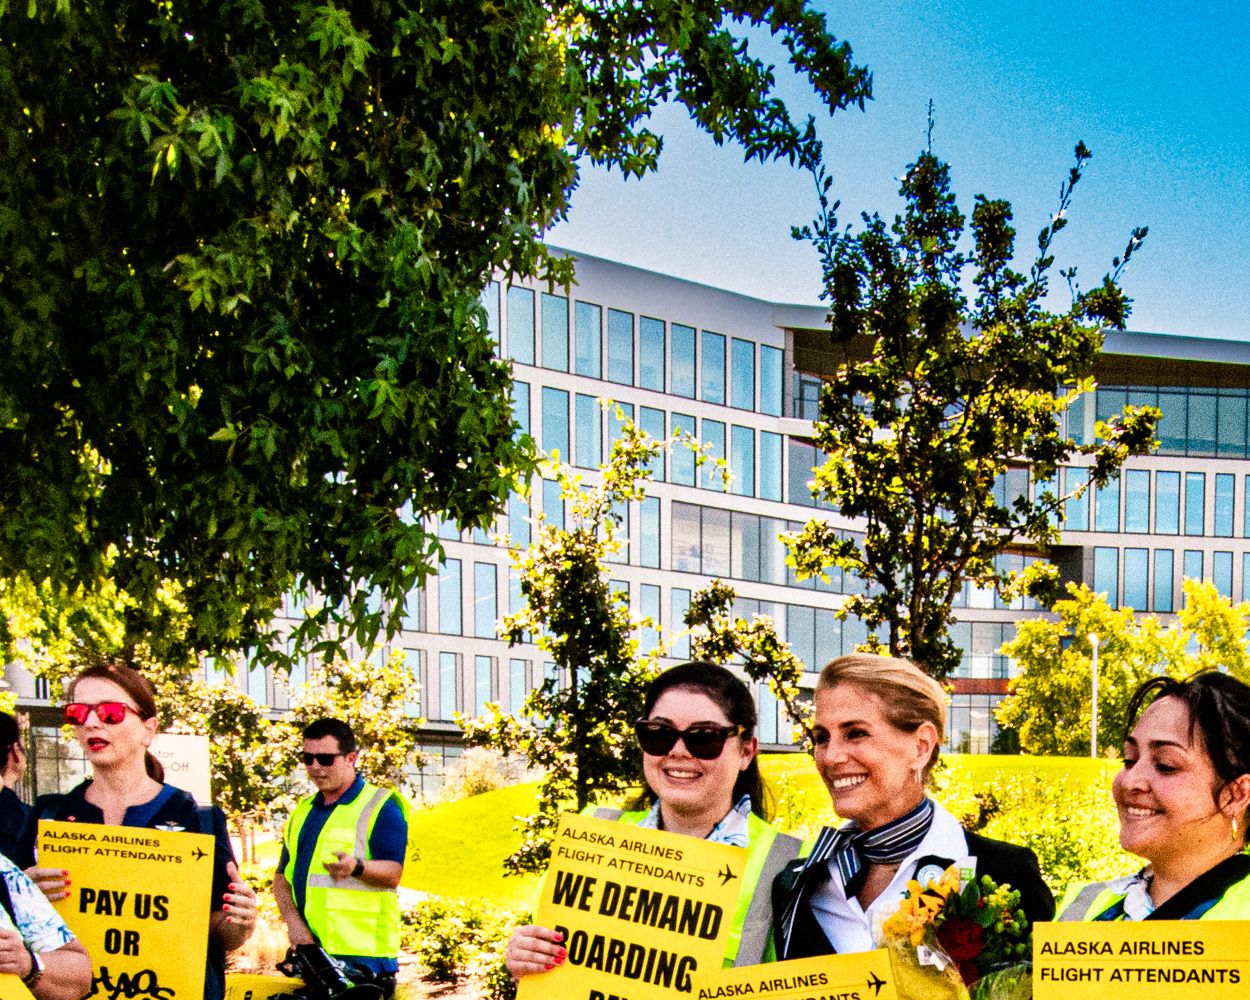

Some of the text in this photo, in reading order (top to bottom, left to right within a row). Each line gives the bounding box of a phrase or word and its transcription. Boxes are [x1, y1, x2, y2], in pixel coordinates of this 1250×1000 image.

[43, 830, 160, 848] ALASKA AIRLINES
[562, 827, 684, 861] ALASKA AIRLINES
[43, 844, 183, 864] FLIGHT ATTENDANTS
[557, 846, 705, 887] FLIGHT ATTENDANTS
[79, 887, 169, 921] PAY US
[552, 870, 724, 941] WE DEMAND
[104, 928, 140, 956] OR
[1040, 940, 1205, 956] ALASKA AIRLINES
[698, 973, 829, 1000] ALASKA AIRLINES
[1040, 968, 1240, 984] FLIGHT ATTENDANTS
